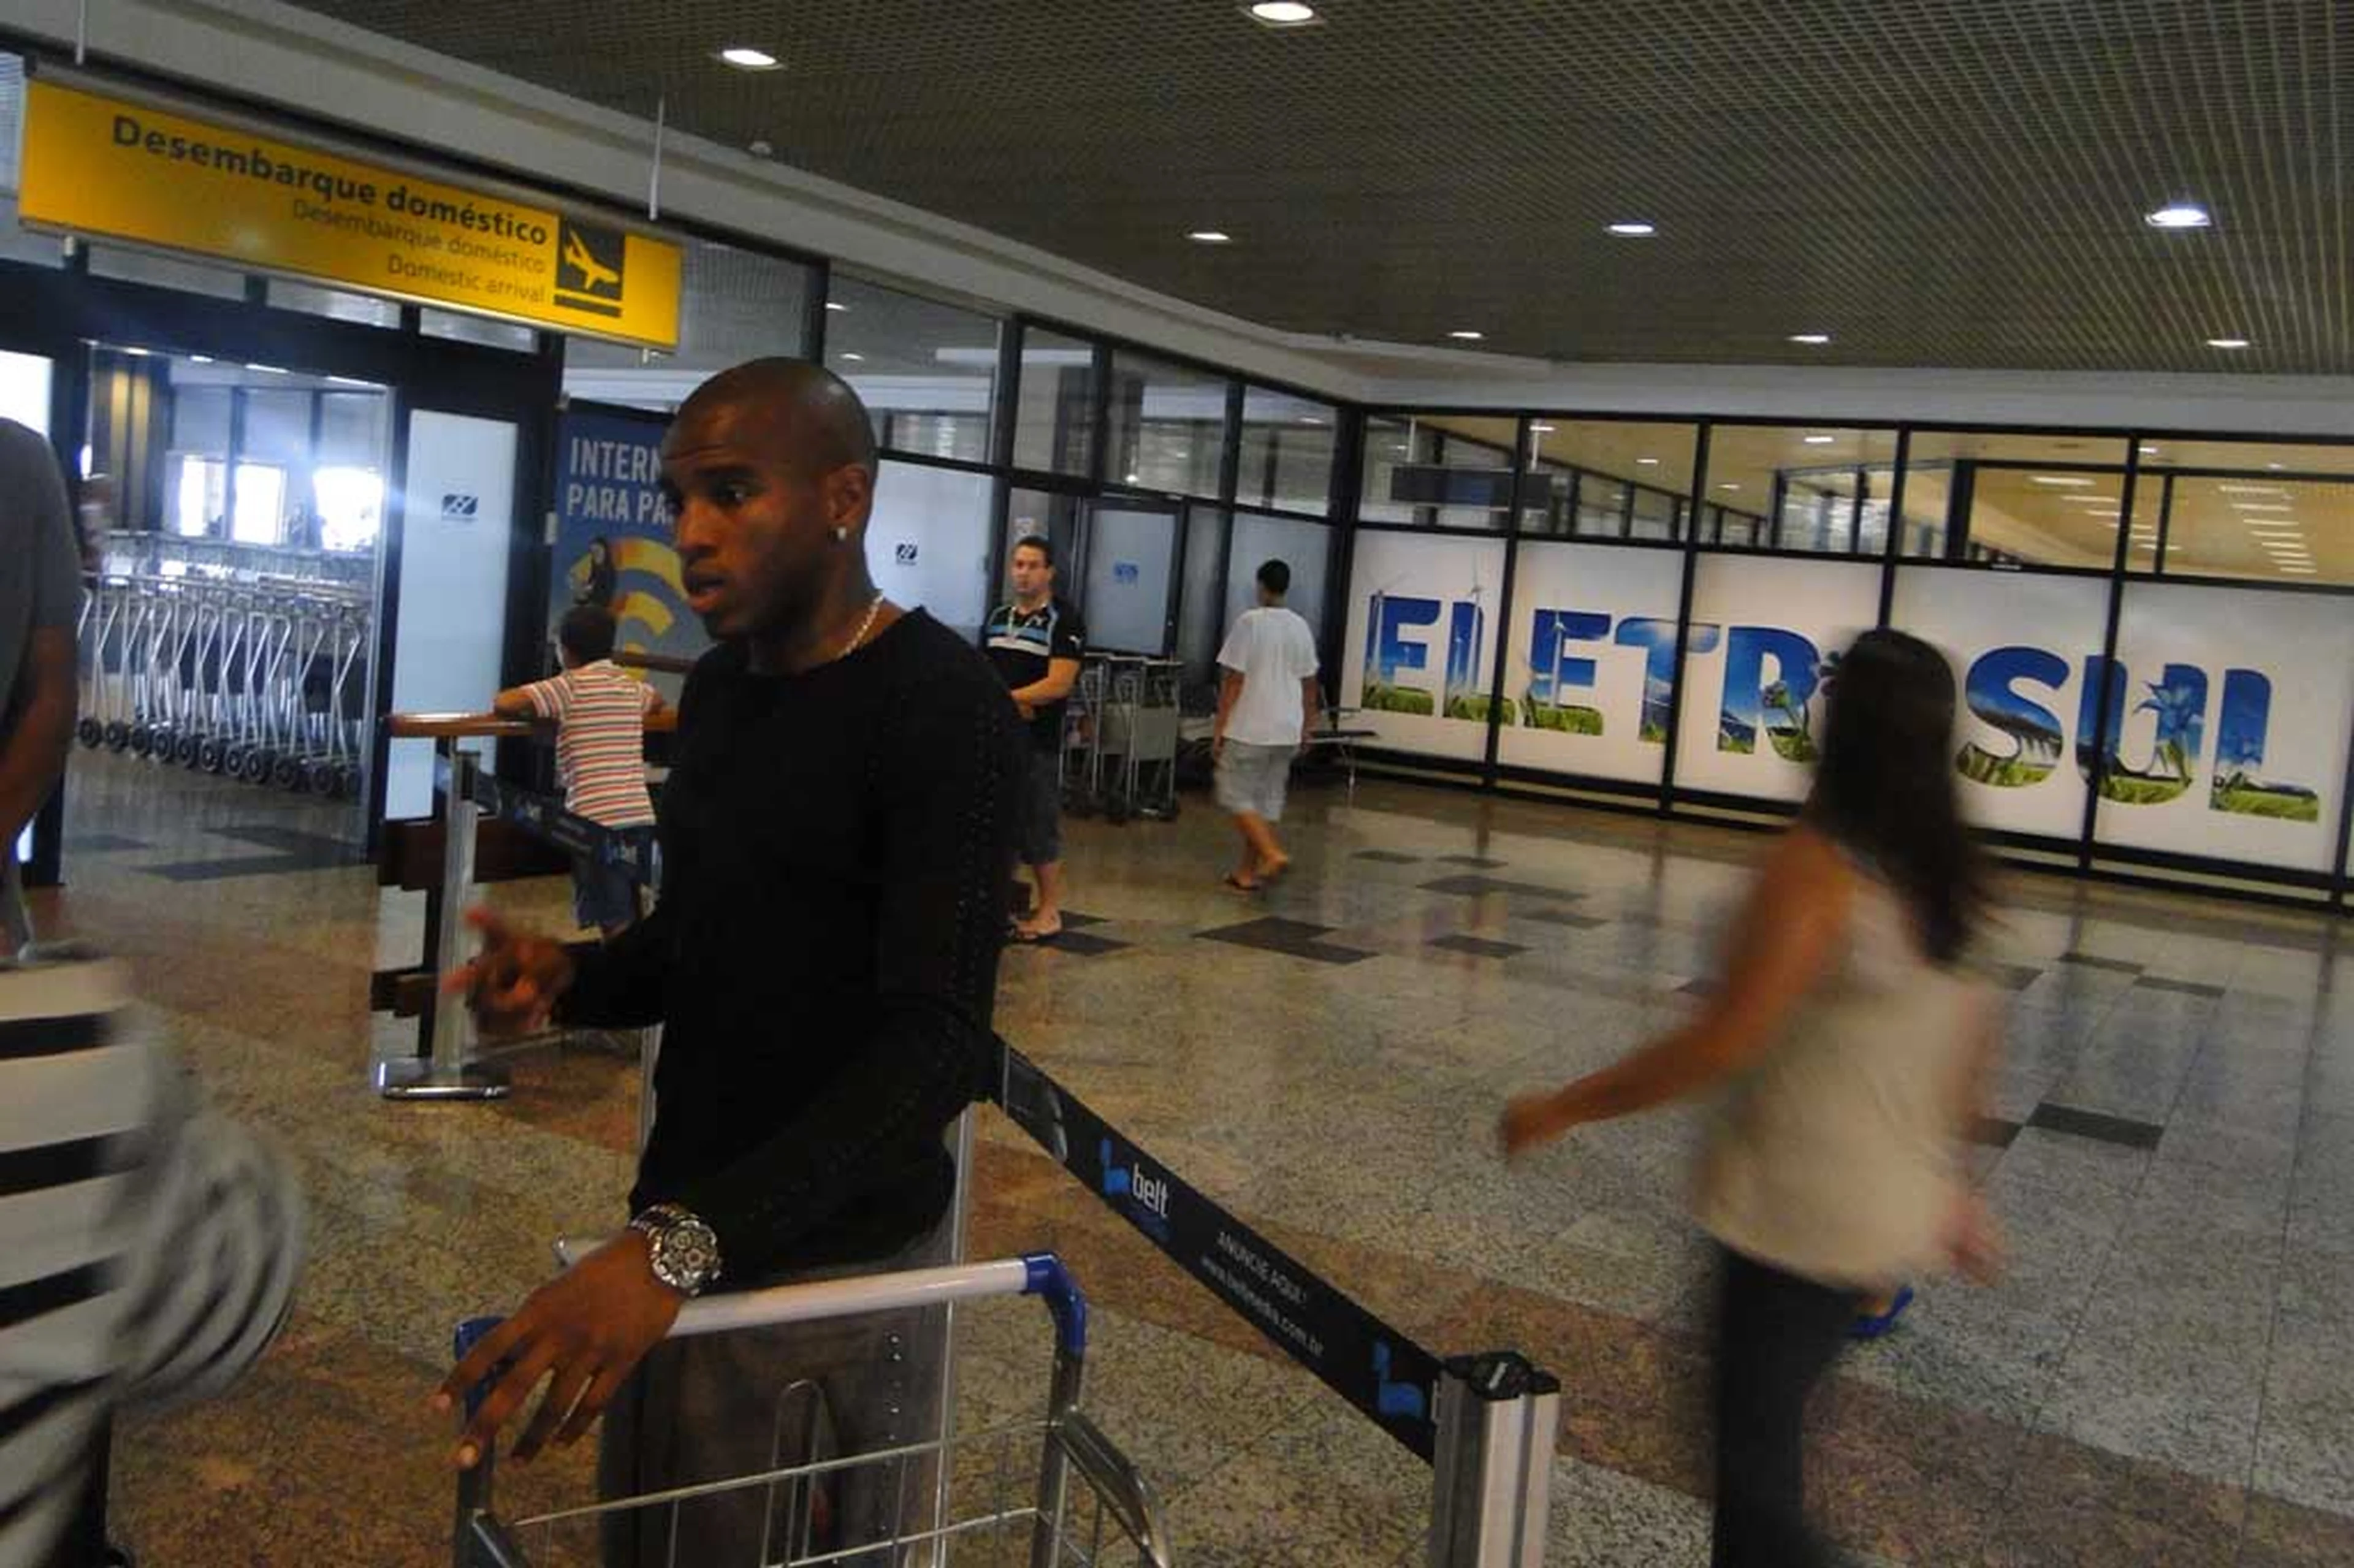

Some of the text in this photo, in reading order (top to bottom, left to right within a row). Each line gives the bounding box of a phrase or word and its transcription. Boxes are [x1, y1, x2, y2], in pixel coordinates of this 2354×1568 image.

[113, 114, 547, 245] Desembarque doméstico
[293, 199, 546, 274] Desembarque doméstico
[387, 253, 546, 302] Domestic arrival
[566, 483, 629, 520] PARA
[1360, 593, 2320, 823] ELETRSUL
[1132, 1162, 1168, 1219] belt
